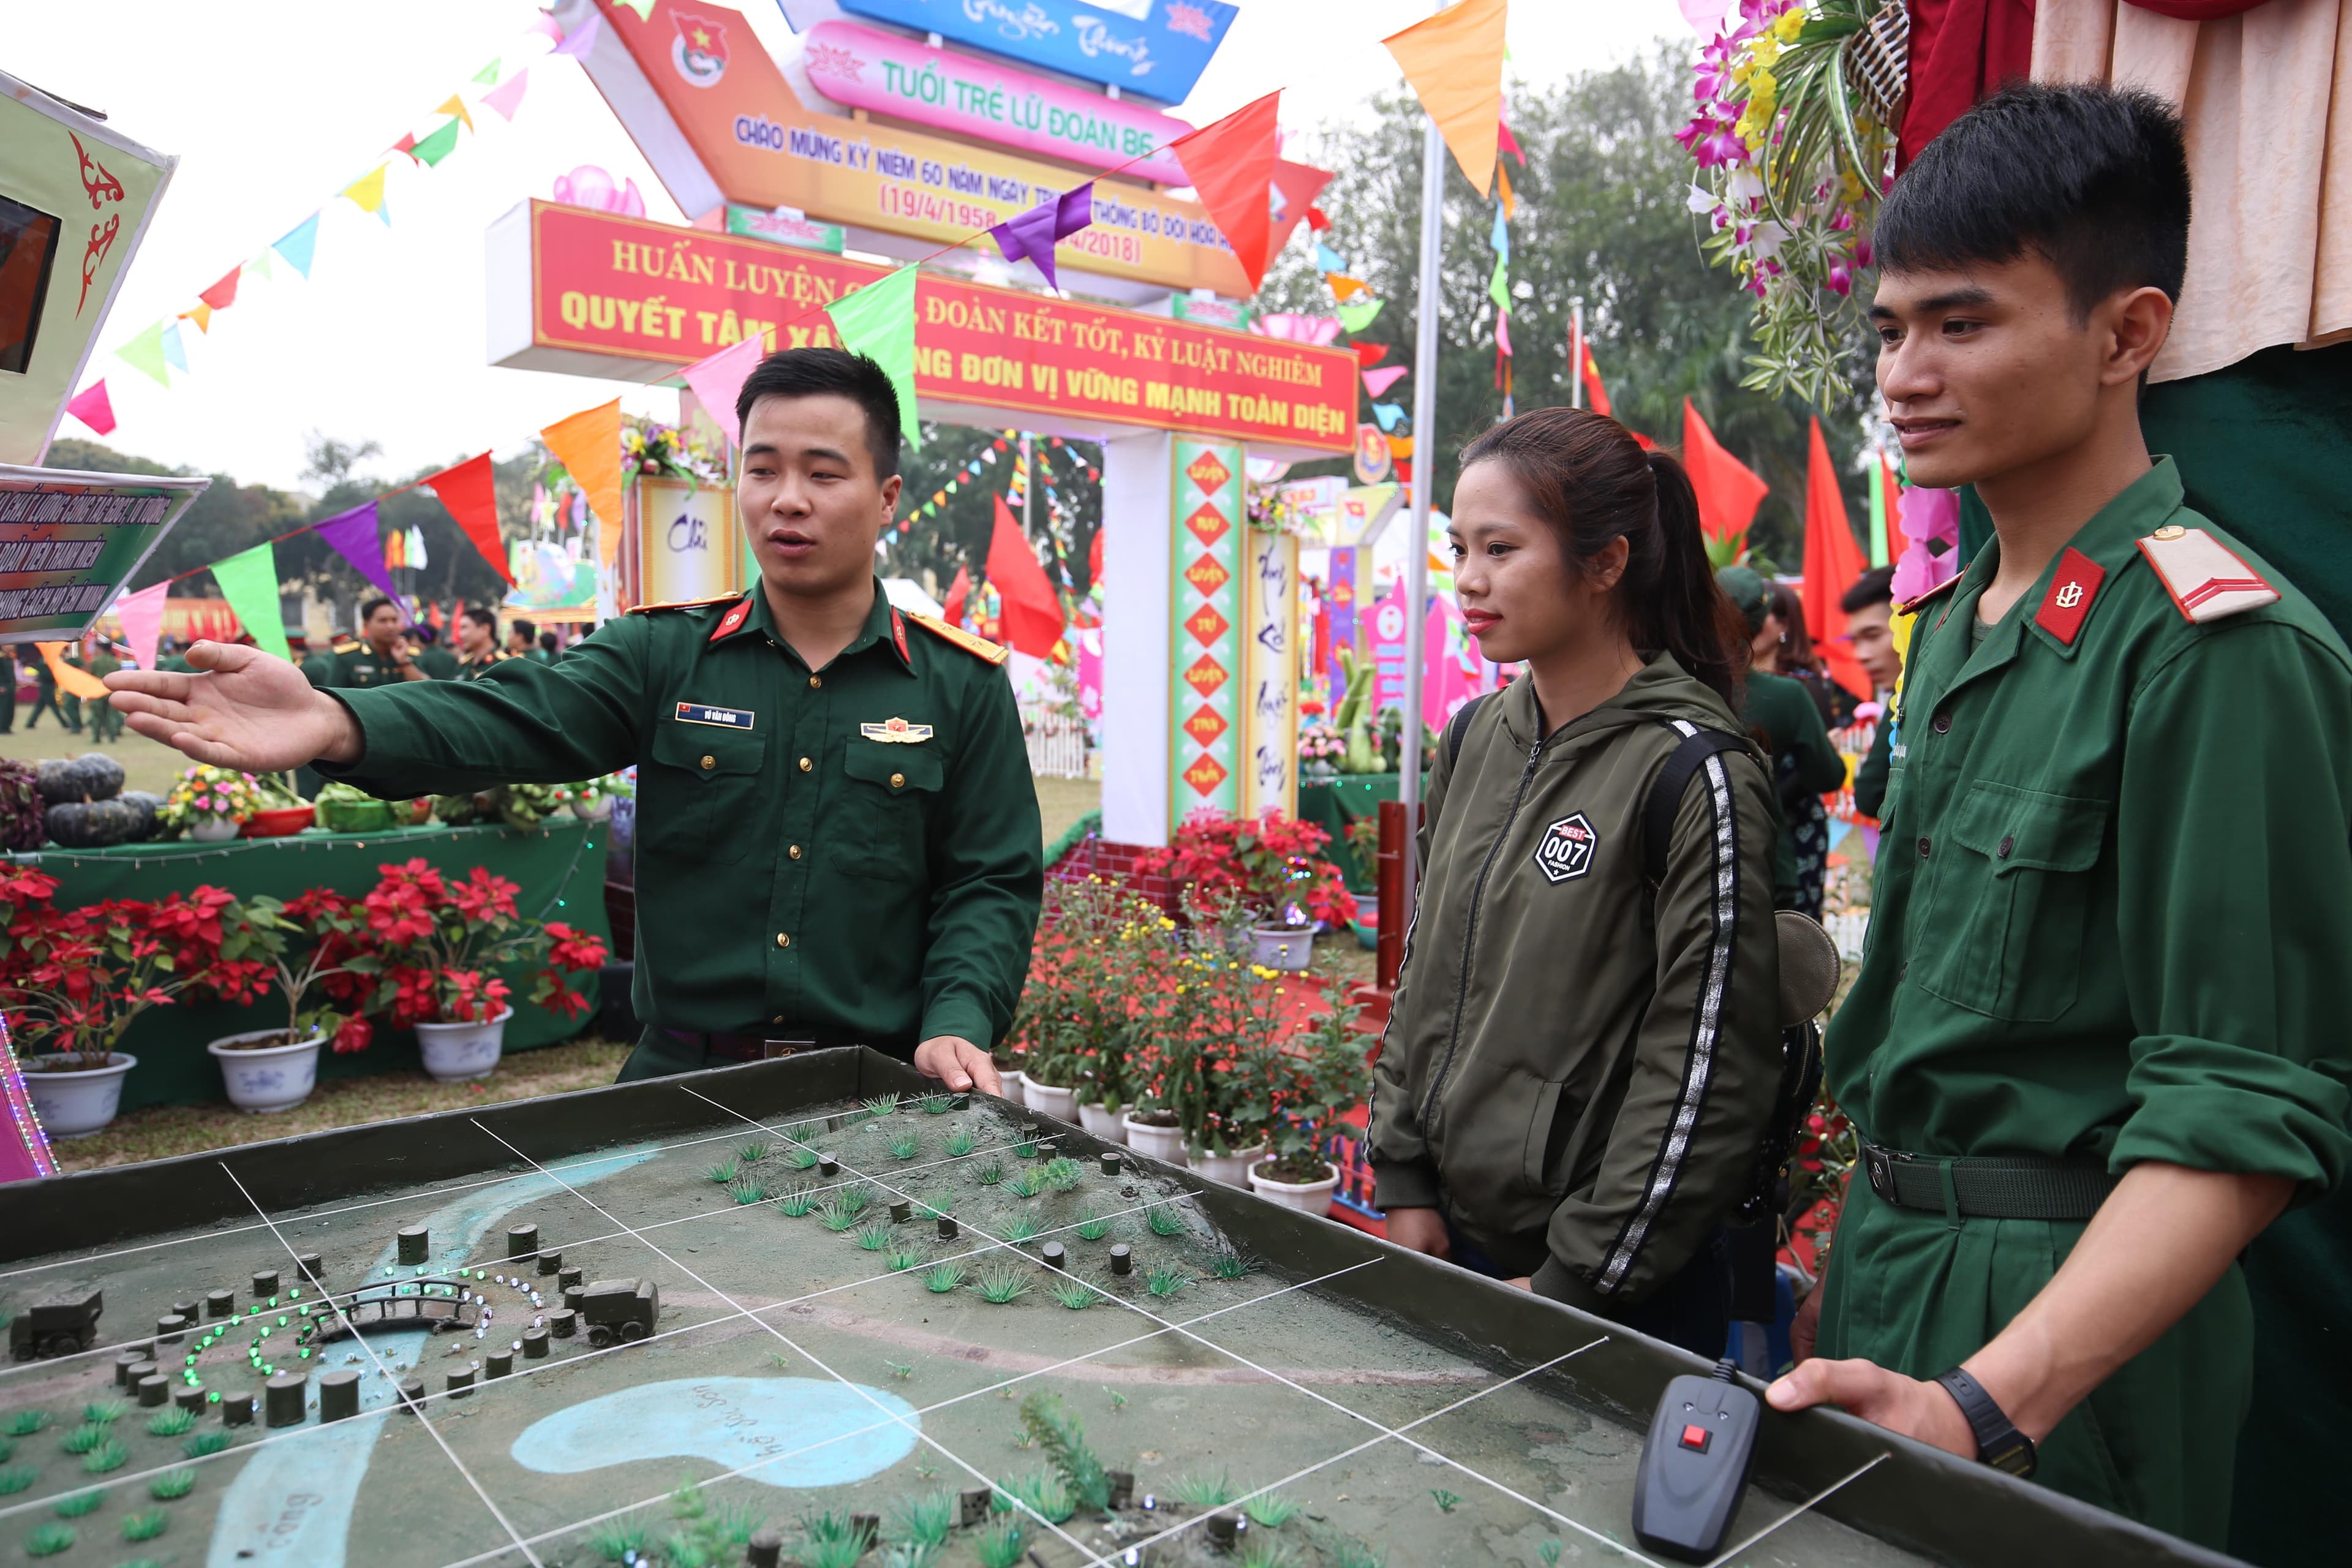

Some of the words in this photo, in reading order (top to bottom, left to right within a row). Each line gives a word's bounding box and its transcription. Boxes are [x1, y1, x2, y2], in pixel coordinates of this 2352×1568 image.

[1049, 107, 1115, 151] ĐOÀN
[922, 161, 942, 186] 60
[612, 239, 715, 285] HUẤN
[725, 260, 835, 309] LUYỆN
[925, 296, 1006, 334] ĐOÀN
[1013, 306, 1067, 345] KẾT
[1071, 317, 1129, 360] TỐT,
[561, 290, 687, 341] QUYẾT
[696, 309, 777, 355] TÂM
[913, 344, 953, 380] NG
[961, 352, 1023, 390] ĐƠN
[1031, 364, 1059, 401] VỊ
[1065, 366, 1139, 405] VỮNG
[1145, 380, 1222, 418] MẠNH
[1227, 393, 1289, 427] TOÀN
[1294, 402, 1346, 438] DIỆN
[0, 589, 30, 620] HONG
[1561, 826, 1585, 839] BEST
[1544, 837, 1587, 865] 007
[1548, 860, 1570, 871] FASHION
